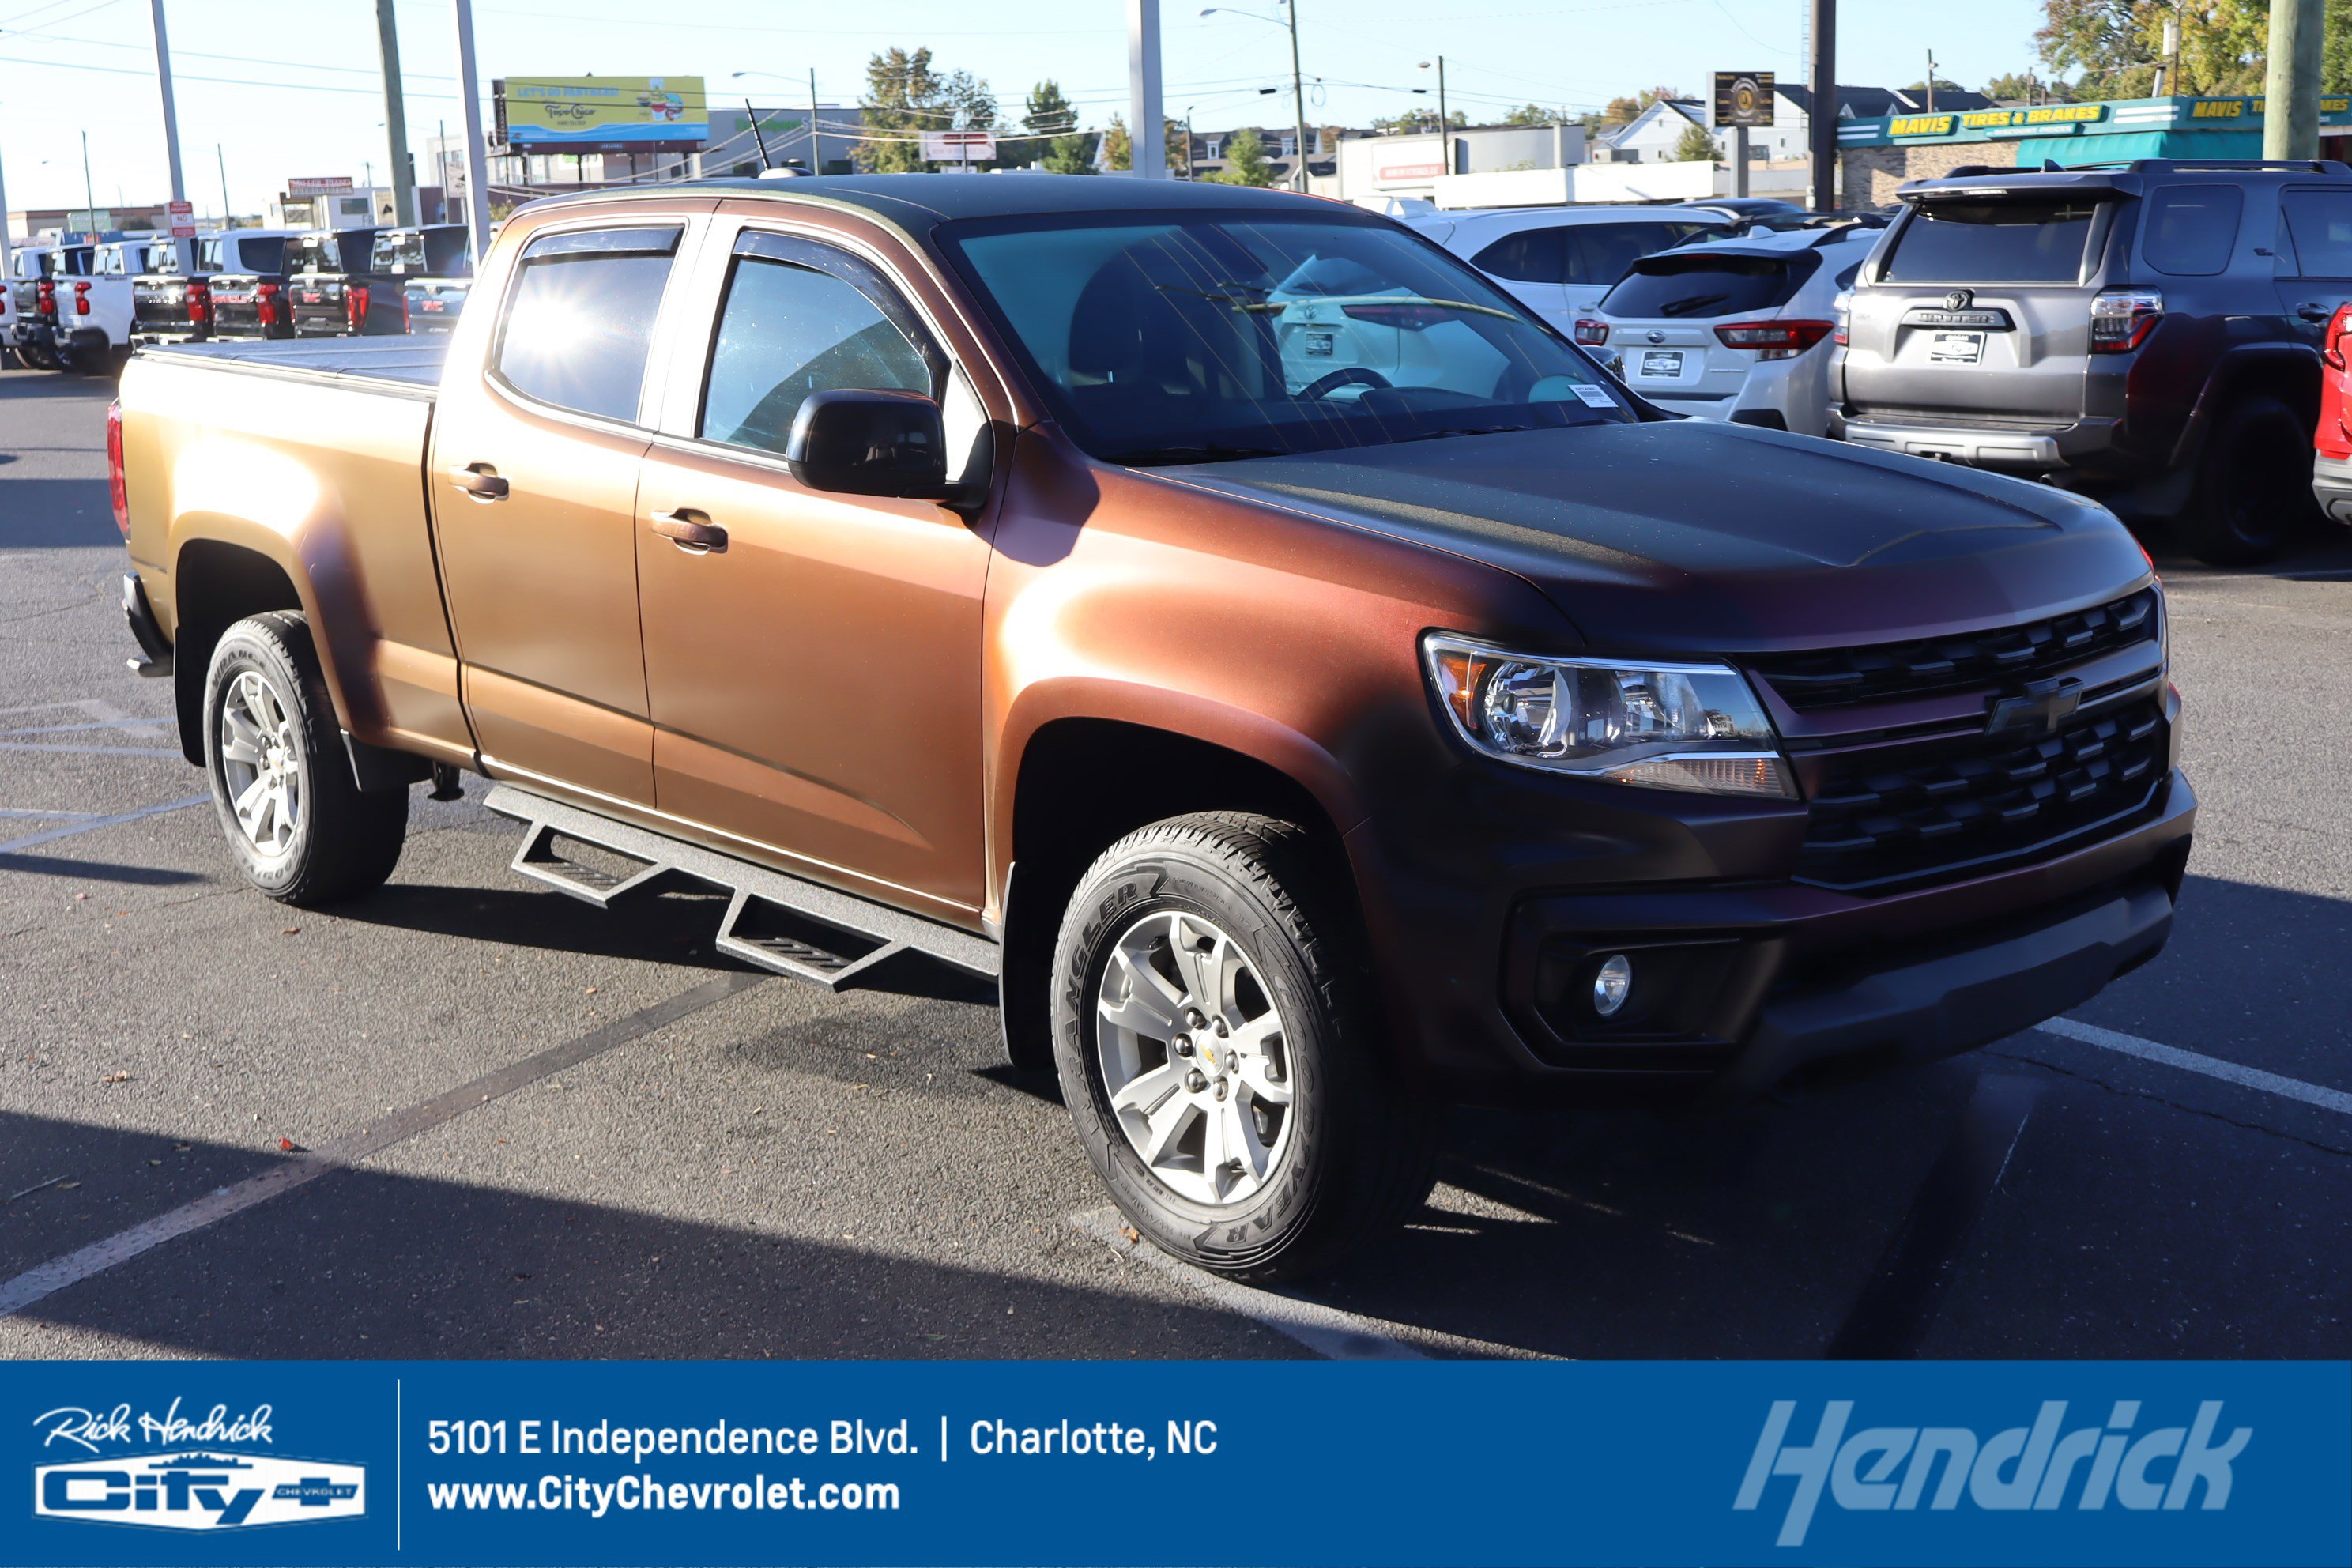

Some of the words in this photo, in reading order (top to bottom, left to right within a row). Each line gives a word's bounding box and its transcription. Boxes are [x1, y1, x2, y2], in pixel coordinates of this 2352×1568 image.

[518, 88, 545, 97] LET'S
[548, 88, 561, 96] GO
[545, 104, 571, 119] Topo
[571, 103, 597, 119] Chico
[2192, 100, 2244, 118] MAVIS
[1889, 116, 1952, 135] MAVIS
[1962, 111, 2011, 127] TIRES
[2013, 112, 2024, 124] &
[2026, 105, 2101, 122] BRAKES
[2039, 125, 2072, 134] PRICES
[1065, 881, 1139, 1136] WRANGLER
[1226, 975, 1316, 1245] GOODYEAR
